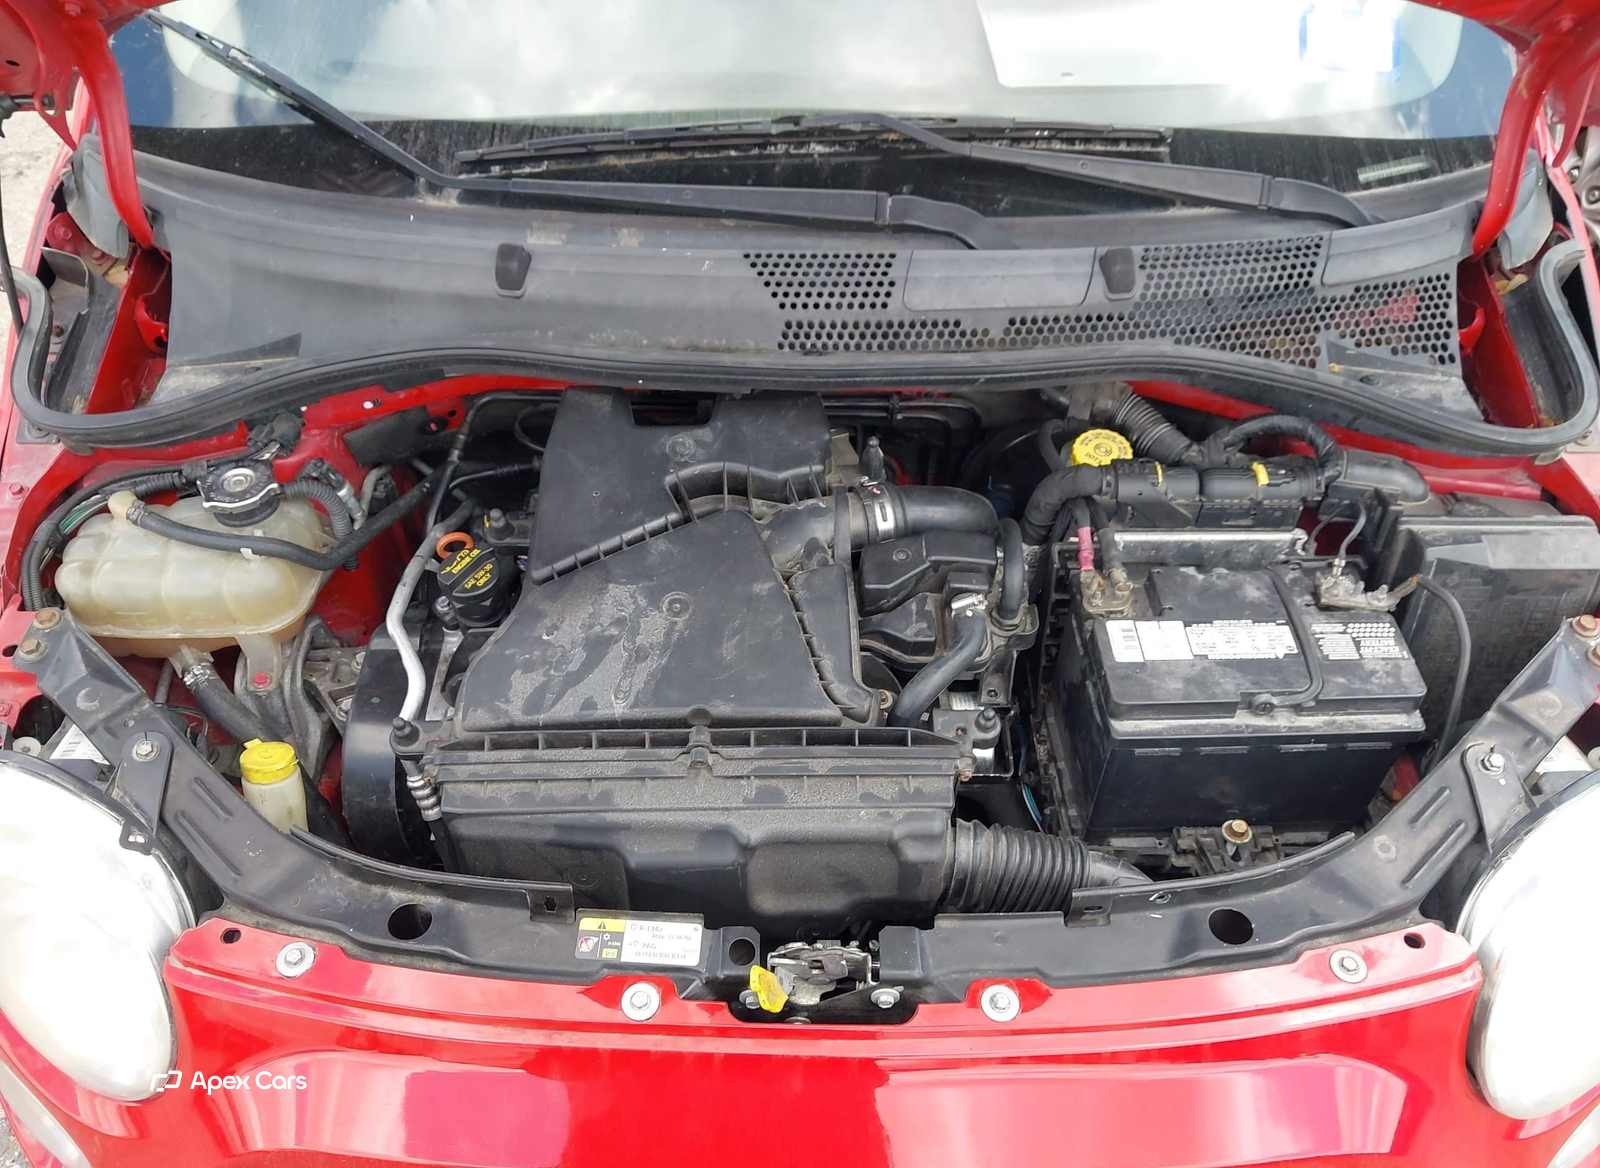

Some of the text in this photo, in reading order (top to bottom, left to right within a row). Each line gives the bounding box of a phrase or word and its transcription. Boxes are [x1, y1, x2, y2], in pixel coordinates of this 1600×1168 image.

[451, 548, 482, 574] ENGINE OIL
[464, 563, 494, 589] SAE 5W-30
[476, 573, 492, 586] ONLY
